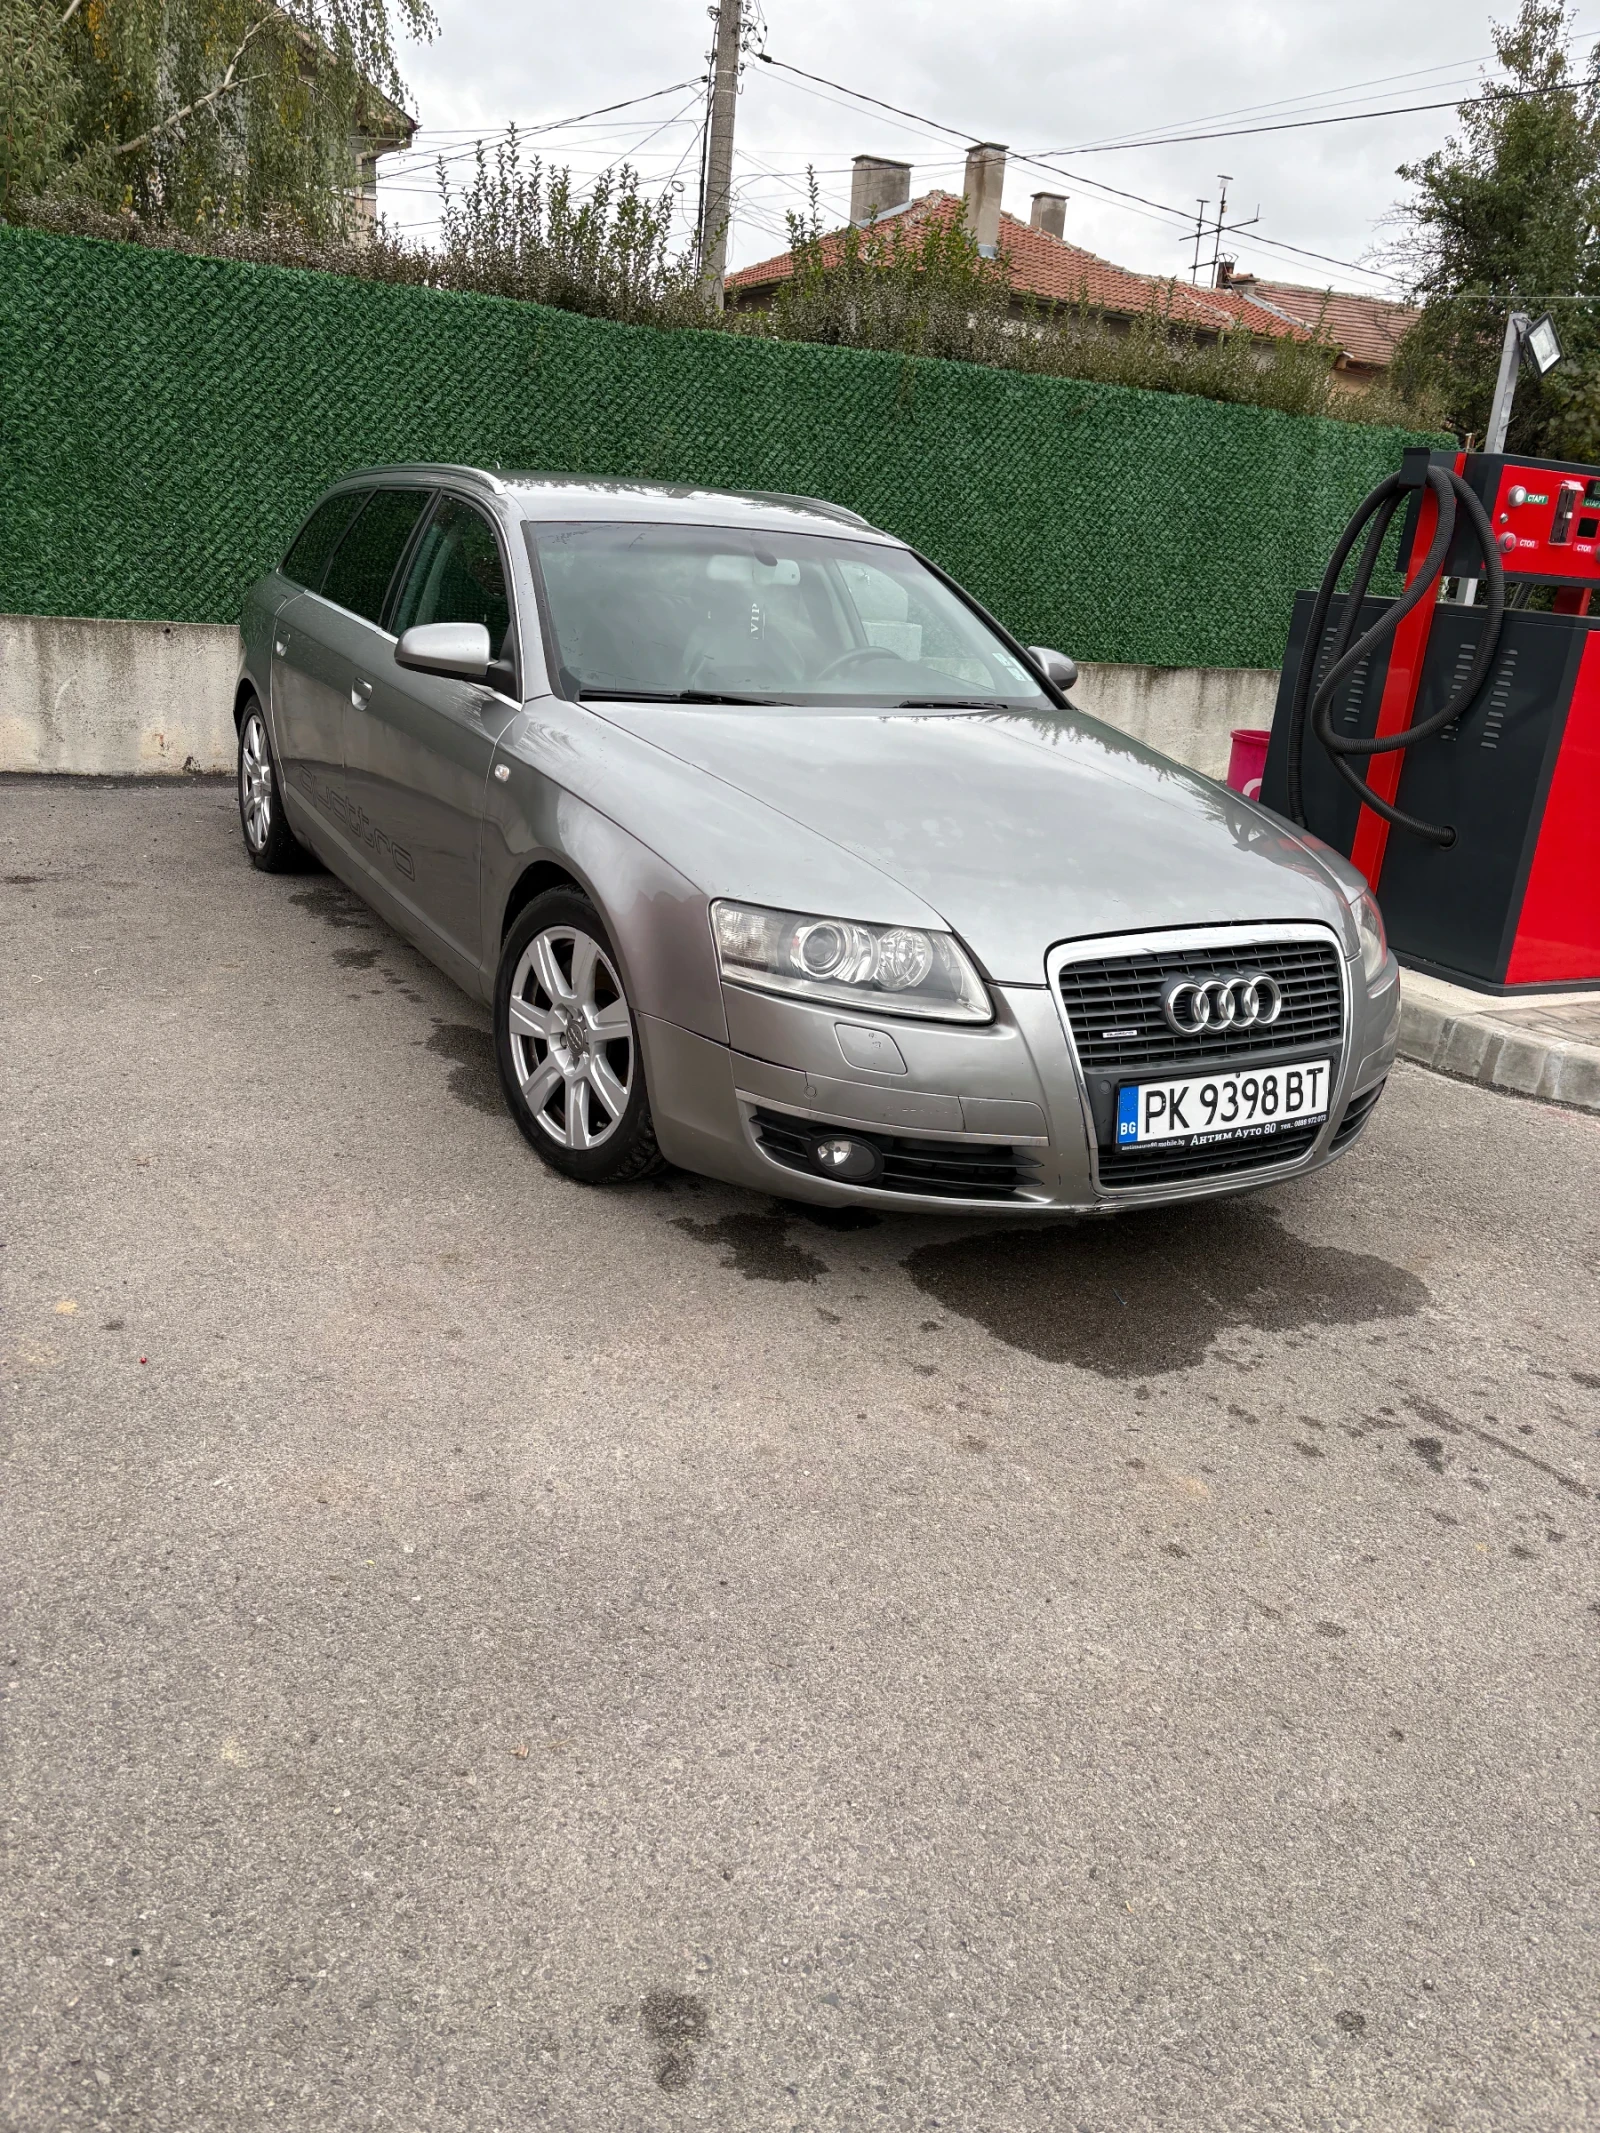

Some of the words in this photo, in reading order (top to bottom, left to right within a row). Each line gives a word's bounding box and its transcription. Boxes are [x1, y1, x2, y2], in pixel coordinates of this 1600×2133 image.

[1527, 495, 1545, 503] СТАРТ
[750, 602, 760, 633] VIP
[1199, 1074, 1279, 1126] 9398
[1120, 1121, 1136, 1135] BG
[1190, 1131, 1232, 1146] Антим
[1235, 1127, 1261, 1139] Ауто
[1264, 1123, 1277, 1134] 80
